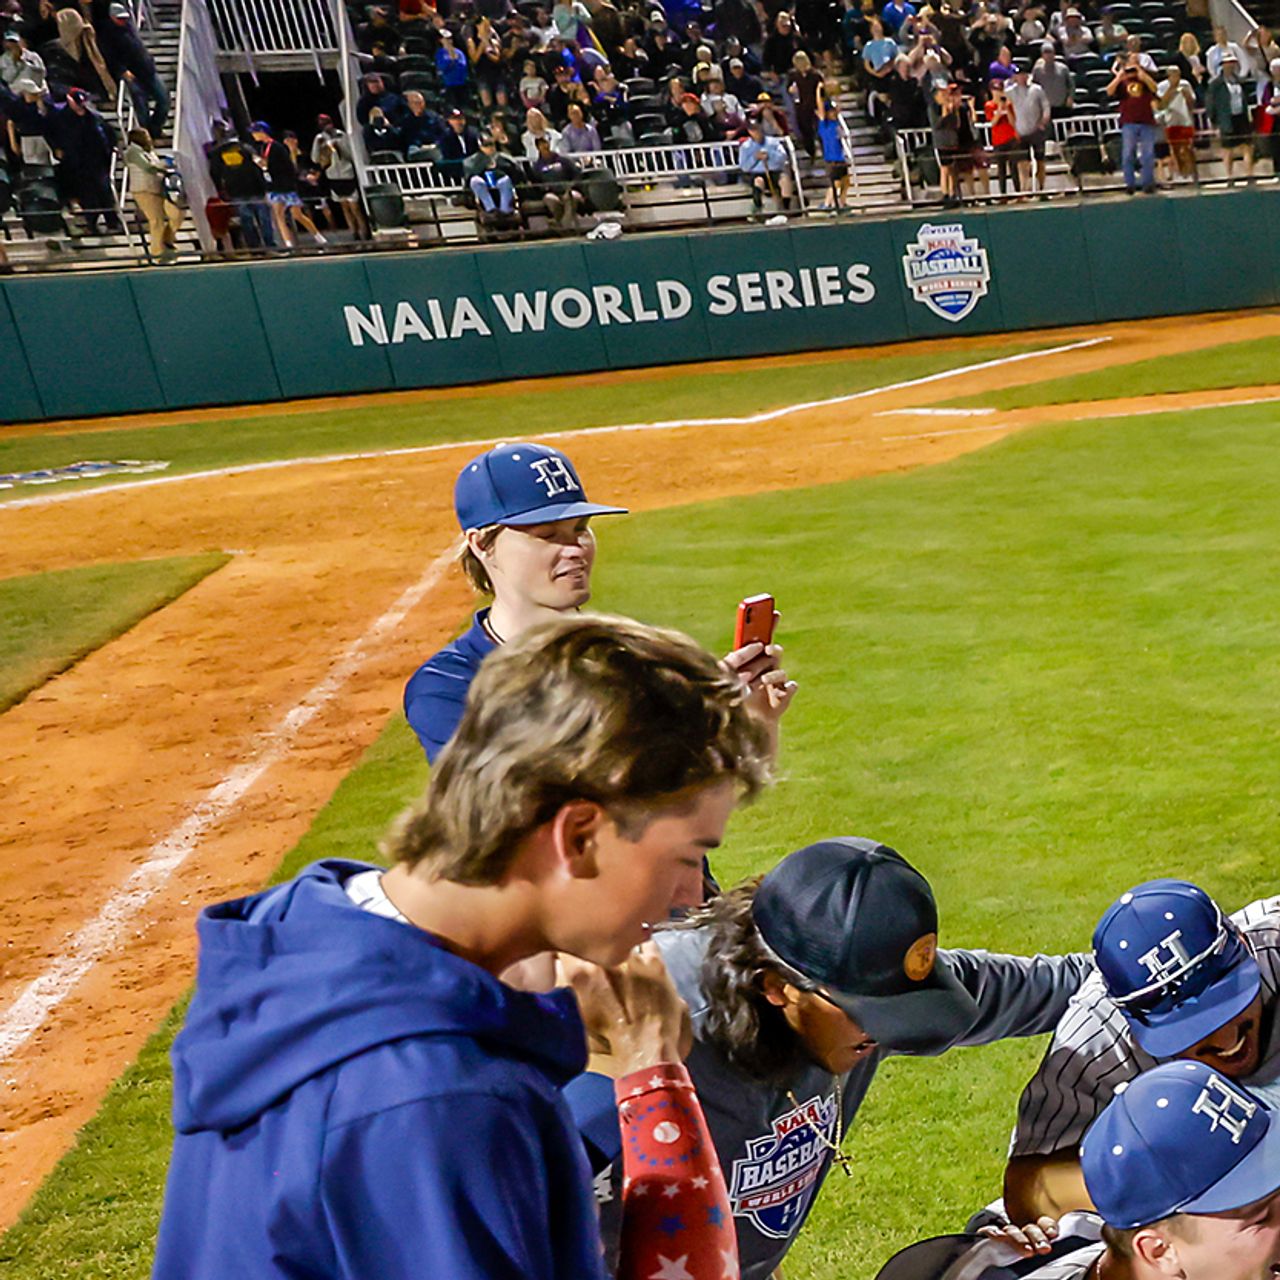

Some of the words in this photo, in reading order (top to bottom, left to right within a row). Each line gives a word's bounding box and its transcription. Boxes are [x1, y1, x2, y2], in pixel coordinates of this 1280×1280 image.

[927, 240, 959, 250] NAIA
[911, 255, 982, 279] BASEBALL
[343, 297, 492, 347] NAIA
[492, 279, 693, 334] WORLD
[706, 263, 876, 316] SERIES
[530, 456, 580, 499] H
[776, 1104, 820, 1139] NAIA
[1192, 1073, 1259, 1146] H
